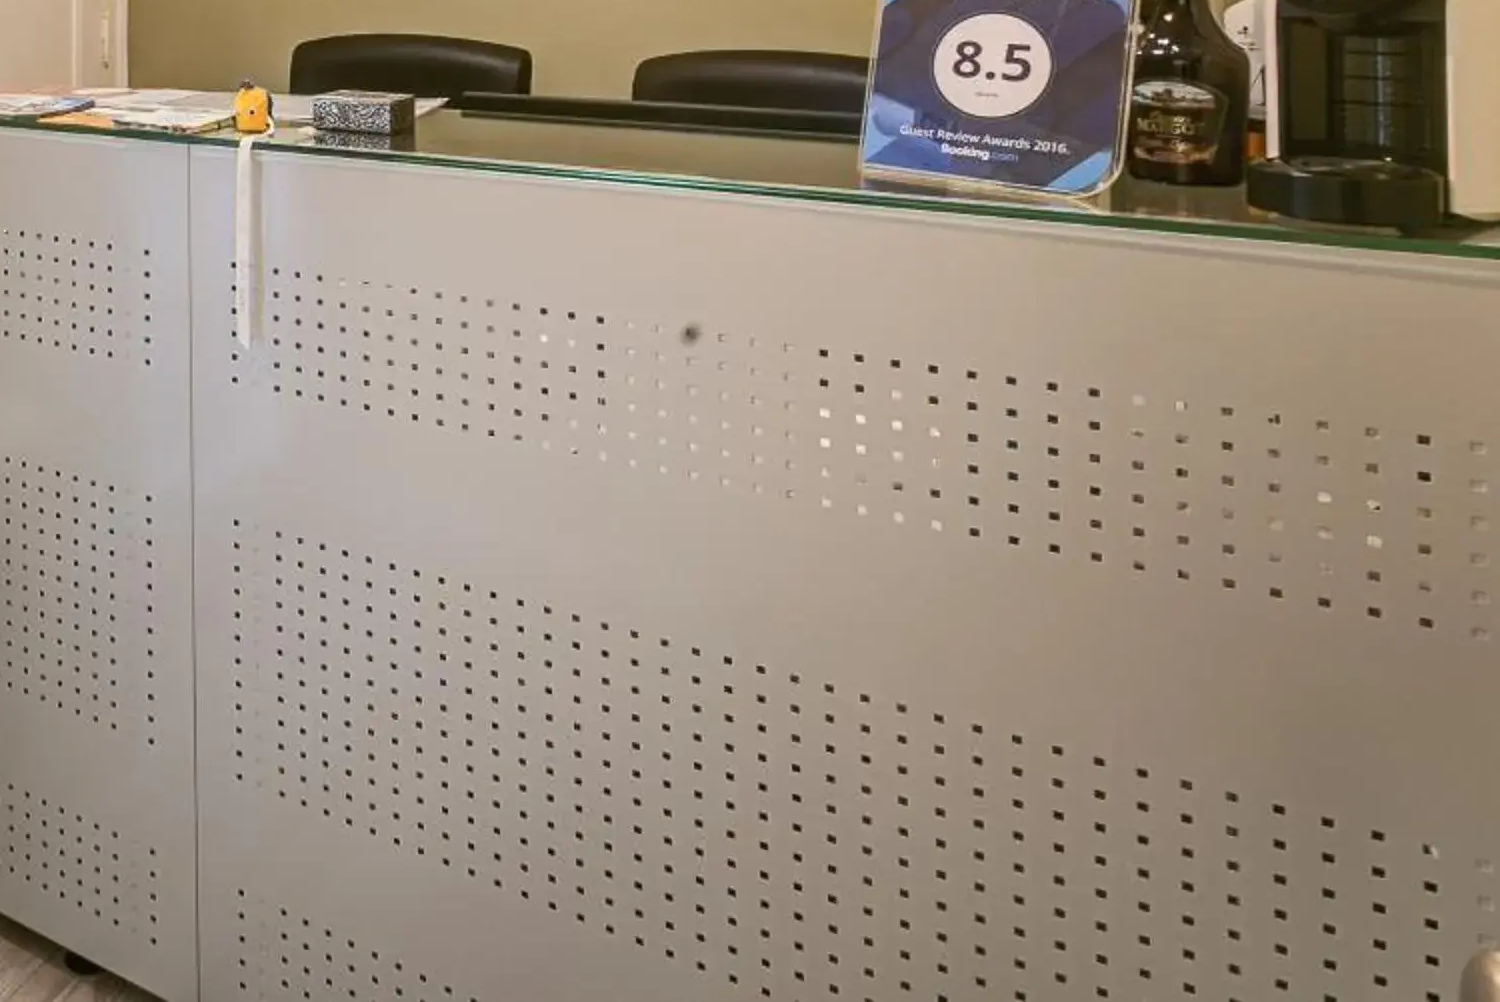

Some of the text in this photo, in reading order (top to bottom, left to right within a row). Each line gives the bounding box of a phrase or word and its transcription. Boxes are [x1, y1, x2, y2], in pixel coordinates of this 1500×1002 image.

[952, 41, 1032, 82] 8.5
[899, 125, 933, 138] Guest
[936, 128, 981, 143] Review
[982, 134, 1031, 150] Awards
